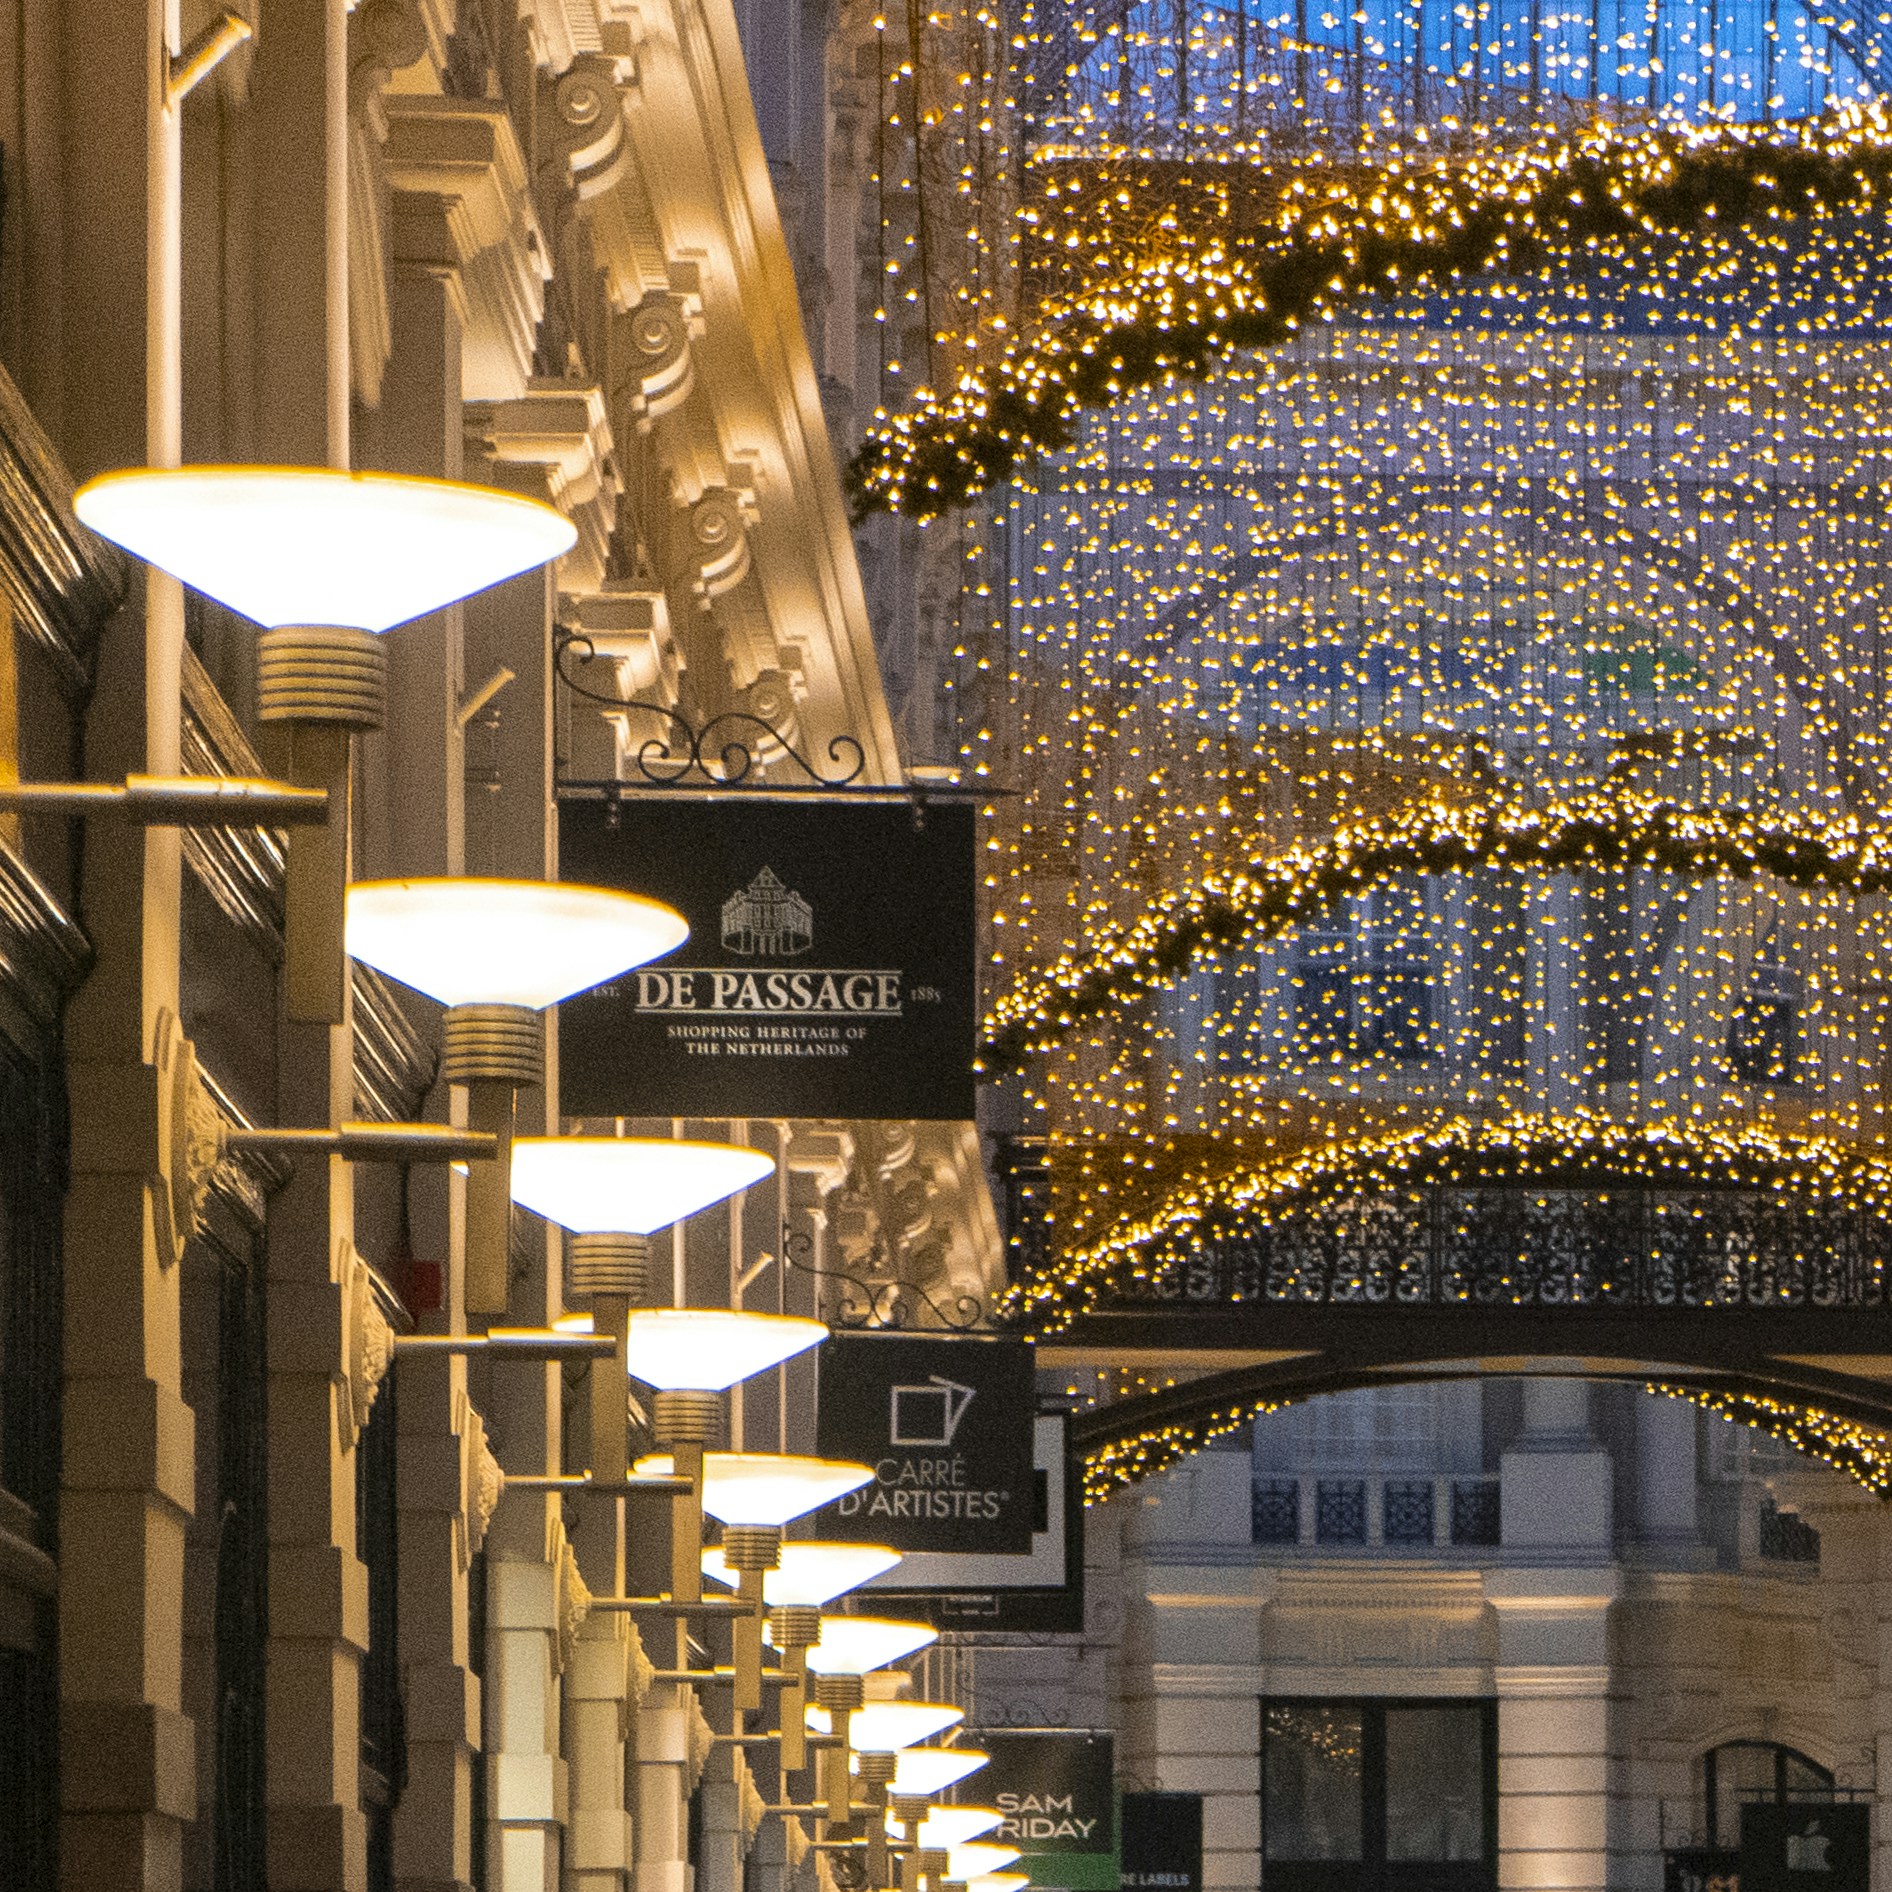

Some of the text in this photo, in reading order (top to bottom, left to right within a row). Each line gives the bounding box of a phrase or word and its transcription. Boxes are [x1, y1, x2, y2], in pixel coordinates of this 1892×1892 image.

[635, 972, 697, 1010] DE
[712, 972, 902, 1010] PASSAGE
[667, 1024, 869, 1040] SHOPPING HERITAGE OF
[686, 1042, 849, 1056] THE NETHERLANDS
[875, 1452, 966, 1487] CARRÉ
[995, 1792, 1074, 1814] SAM
[996, 1818, 1097, 1839] RIDAY
[1139, 1873, 1190, 1887] LABELS
